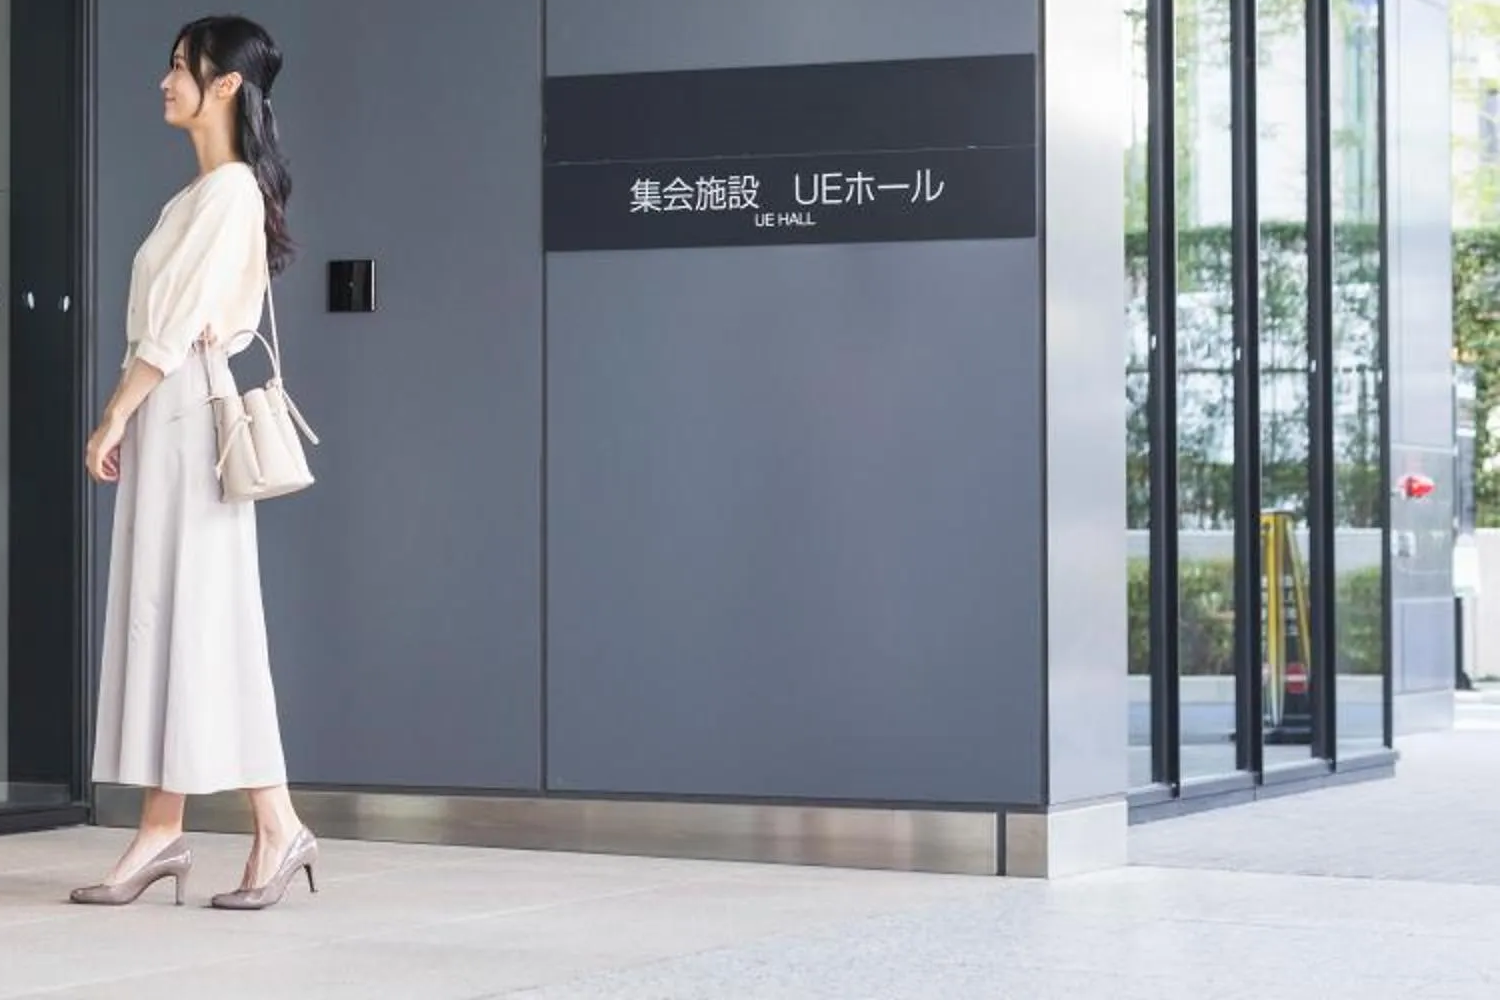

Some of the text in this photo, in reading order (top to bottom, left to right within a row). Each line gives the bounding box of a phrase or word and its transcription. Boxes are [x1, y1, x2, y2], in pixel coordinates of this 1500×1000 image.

[630, 168, 945, 213] 集会施設 UEホール
[755, 212, 817, 227] UE HALL
